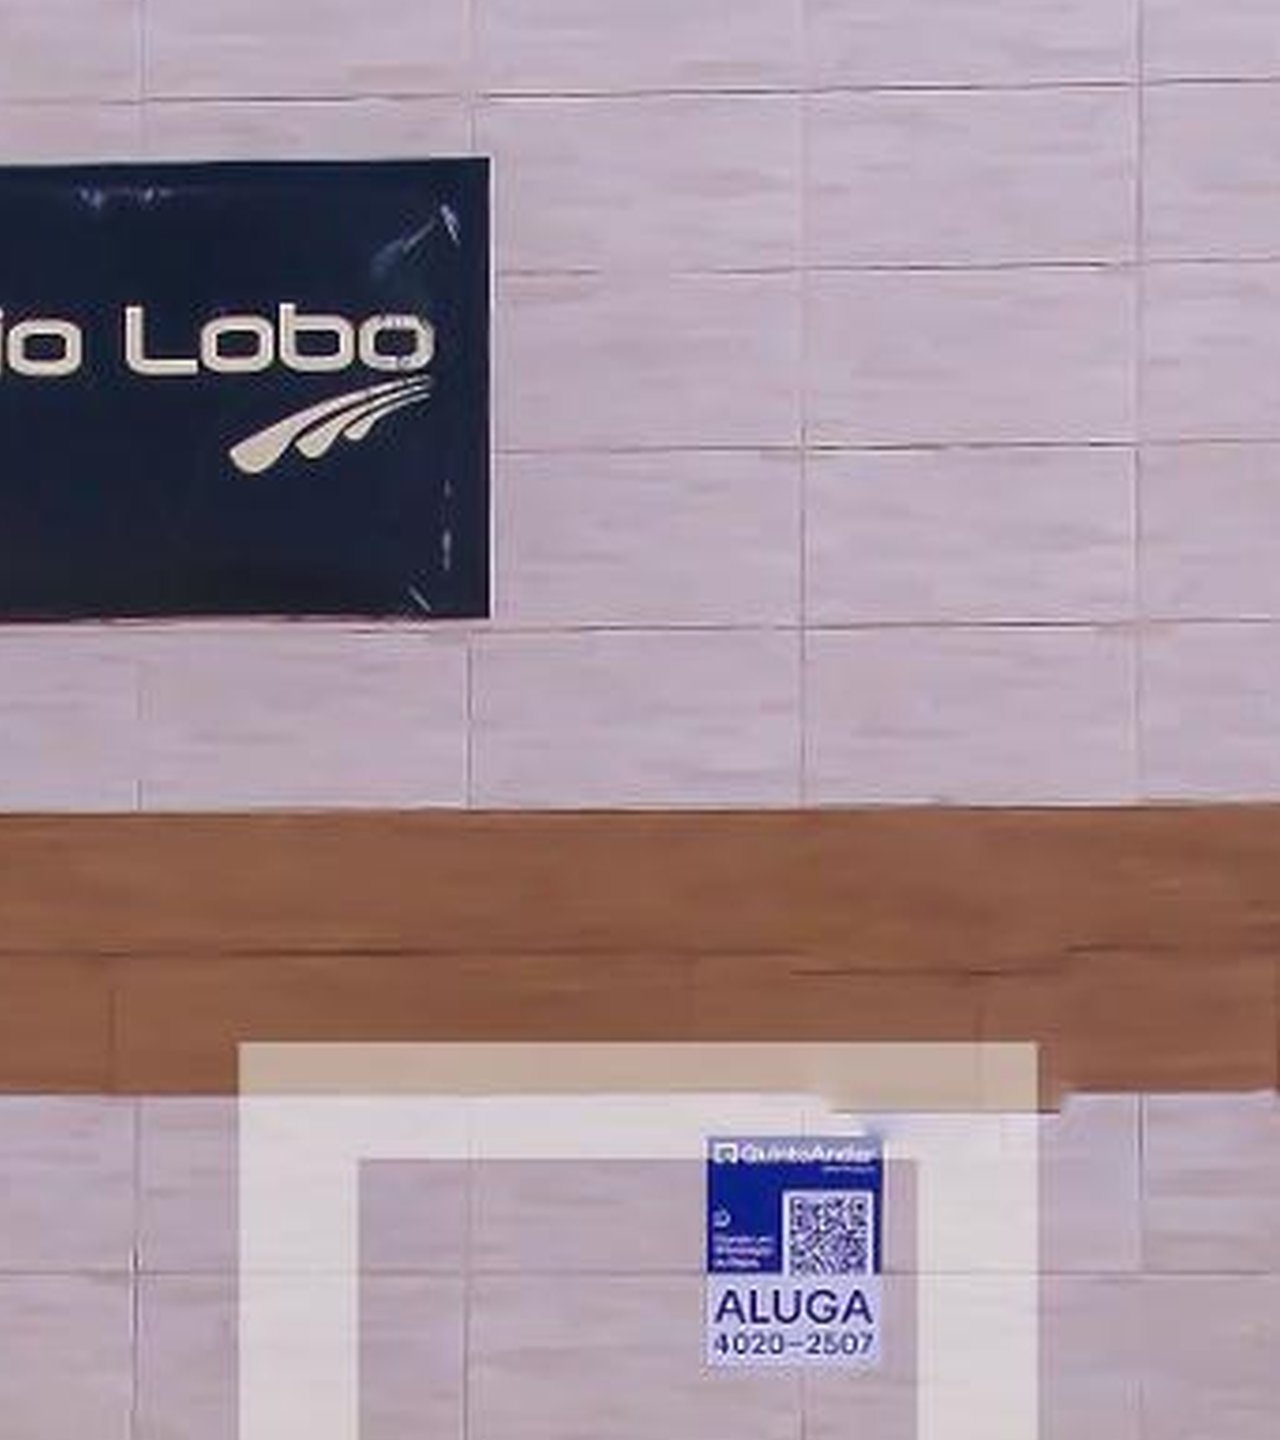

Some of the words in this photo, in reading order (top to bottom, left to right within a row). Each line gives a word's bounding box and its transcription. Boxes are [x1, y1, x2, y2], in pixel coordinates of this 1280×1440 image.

[123, 301, 436, 377] Lobo
[740, 1142, 877, 1163] QuintoAndar
[714, 1289, 874, 1324] ALUGA
[714, 1333, 874, 1355] 4020-2507
